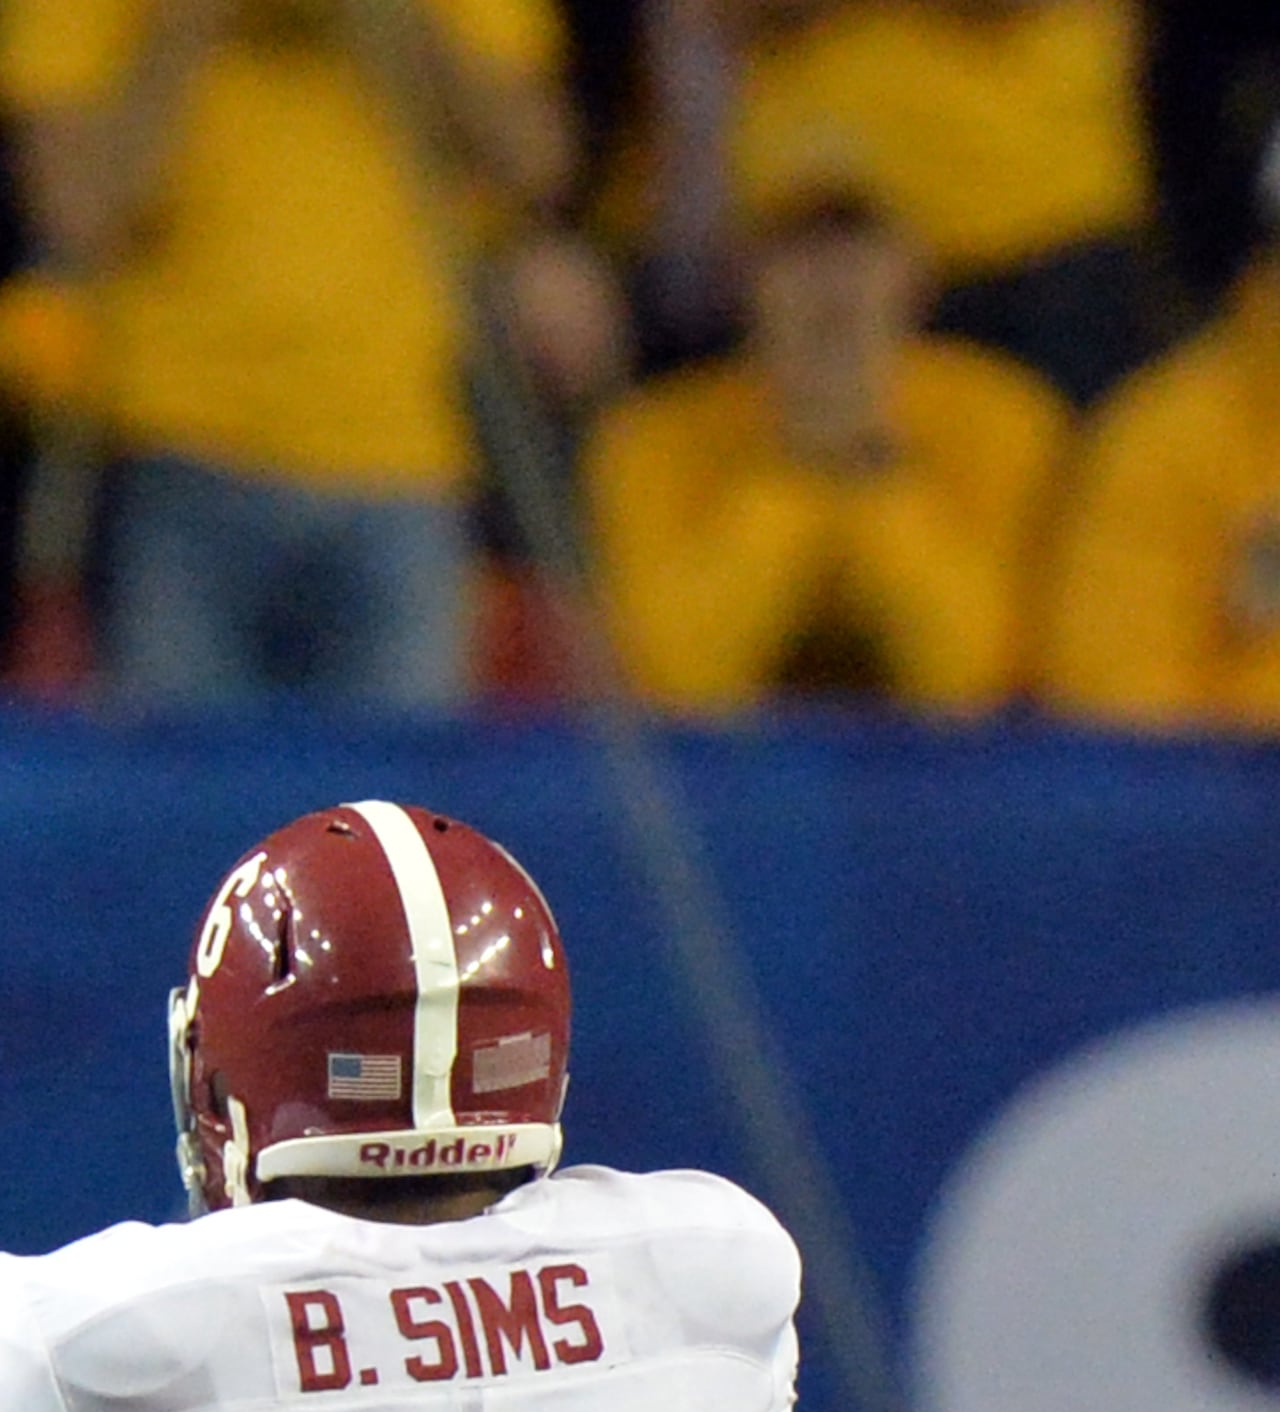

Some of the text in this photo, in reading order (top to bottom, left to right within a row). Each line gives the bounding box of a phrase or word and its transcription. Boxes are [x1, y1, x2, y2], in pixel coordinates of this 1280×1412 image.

[196, 850, 268, 978] 6
[284, 1263, 605, 1392] B. SIMS
